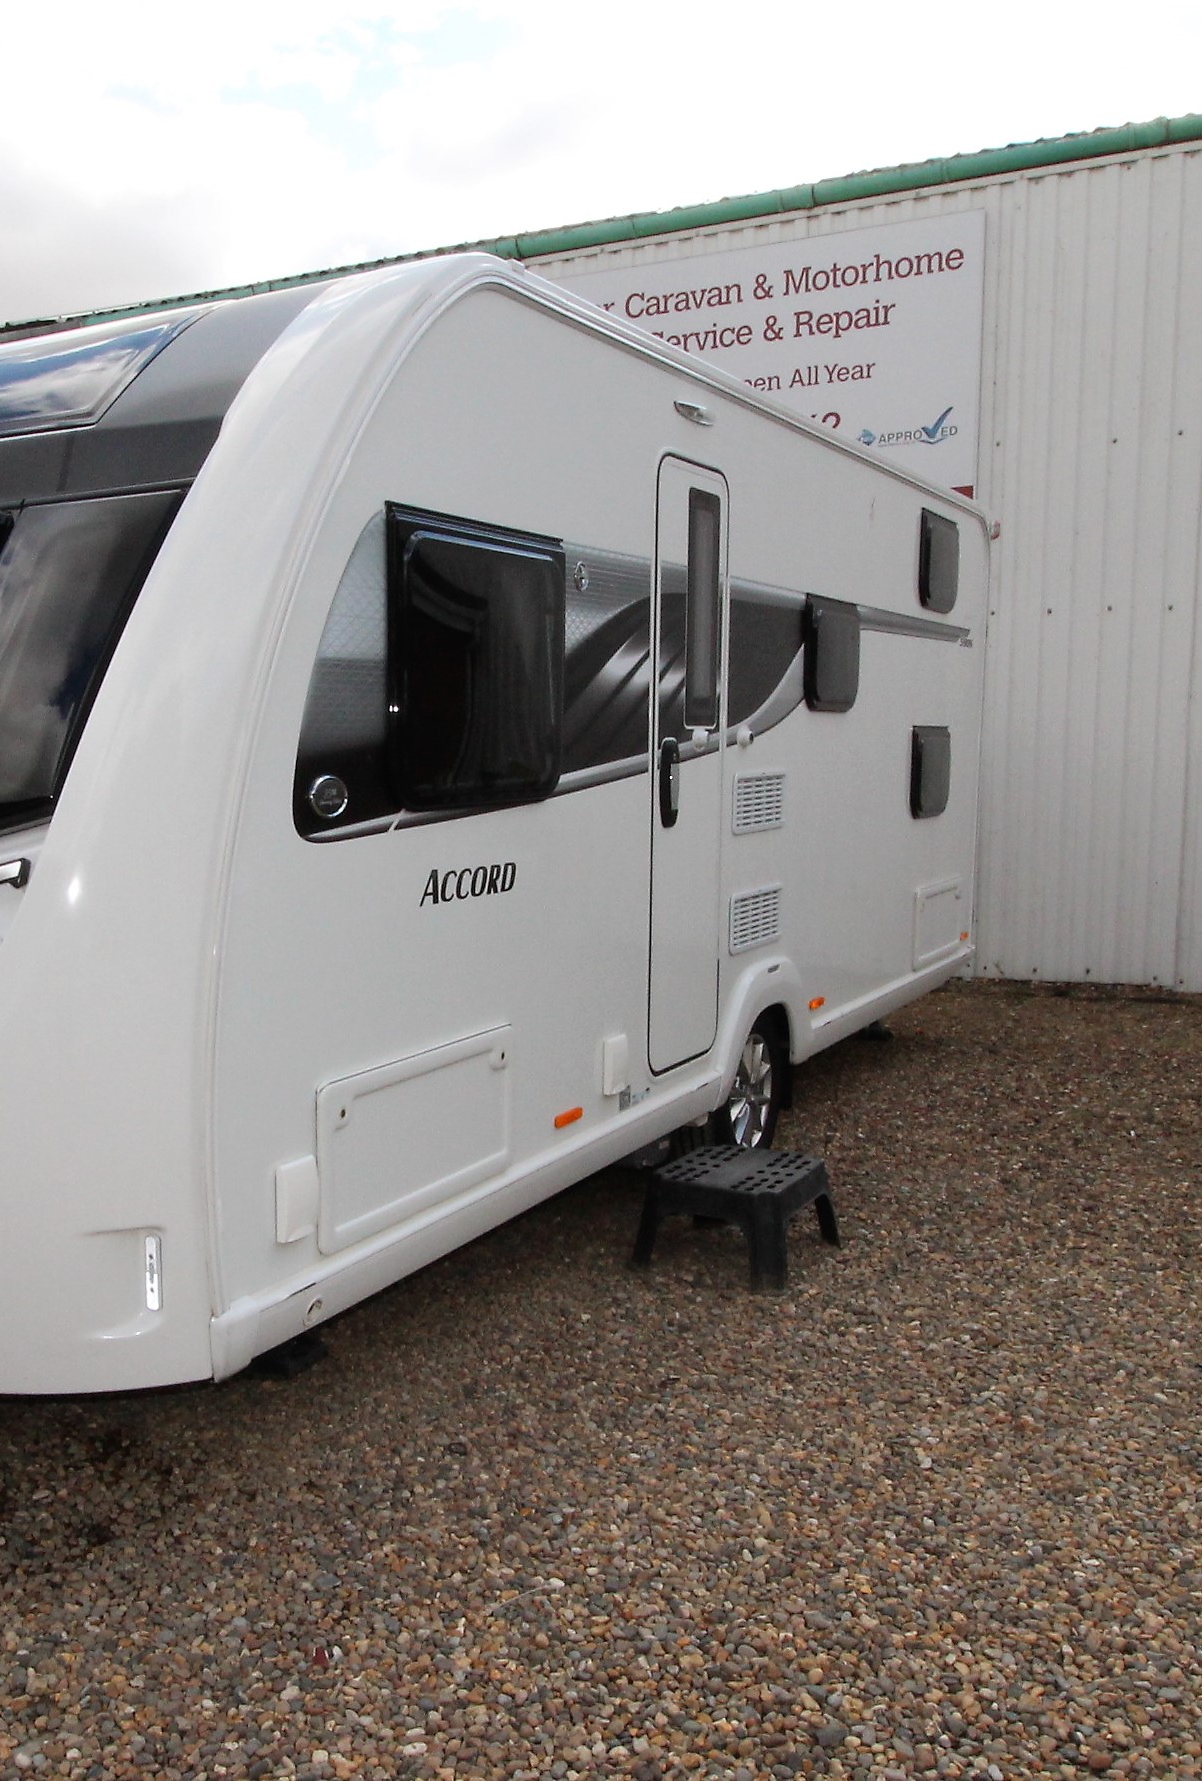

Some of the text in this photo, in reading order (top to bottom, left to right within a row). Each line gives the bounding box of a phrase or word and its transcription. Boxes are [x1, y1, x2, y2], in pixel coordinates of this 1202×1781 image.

[624, 248, 965, 318] Caravan & Motorhome
[762, 315, 784, 342] &
[792, 299, 896, 339] Repair
[789, 365, 820, 389] All
[823, 362, 876, 384] Year
[419, 862, 517, 907] ACCORD
